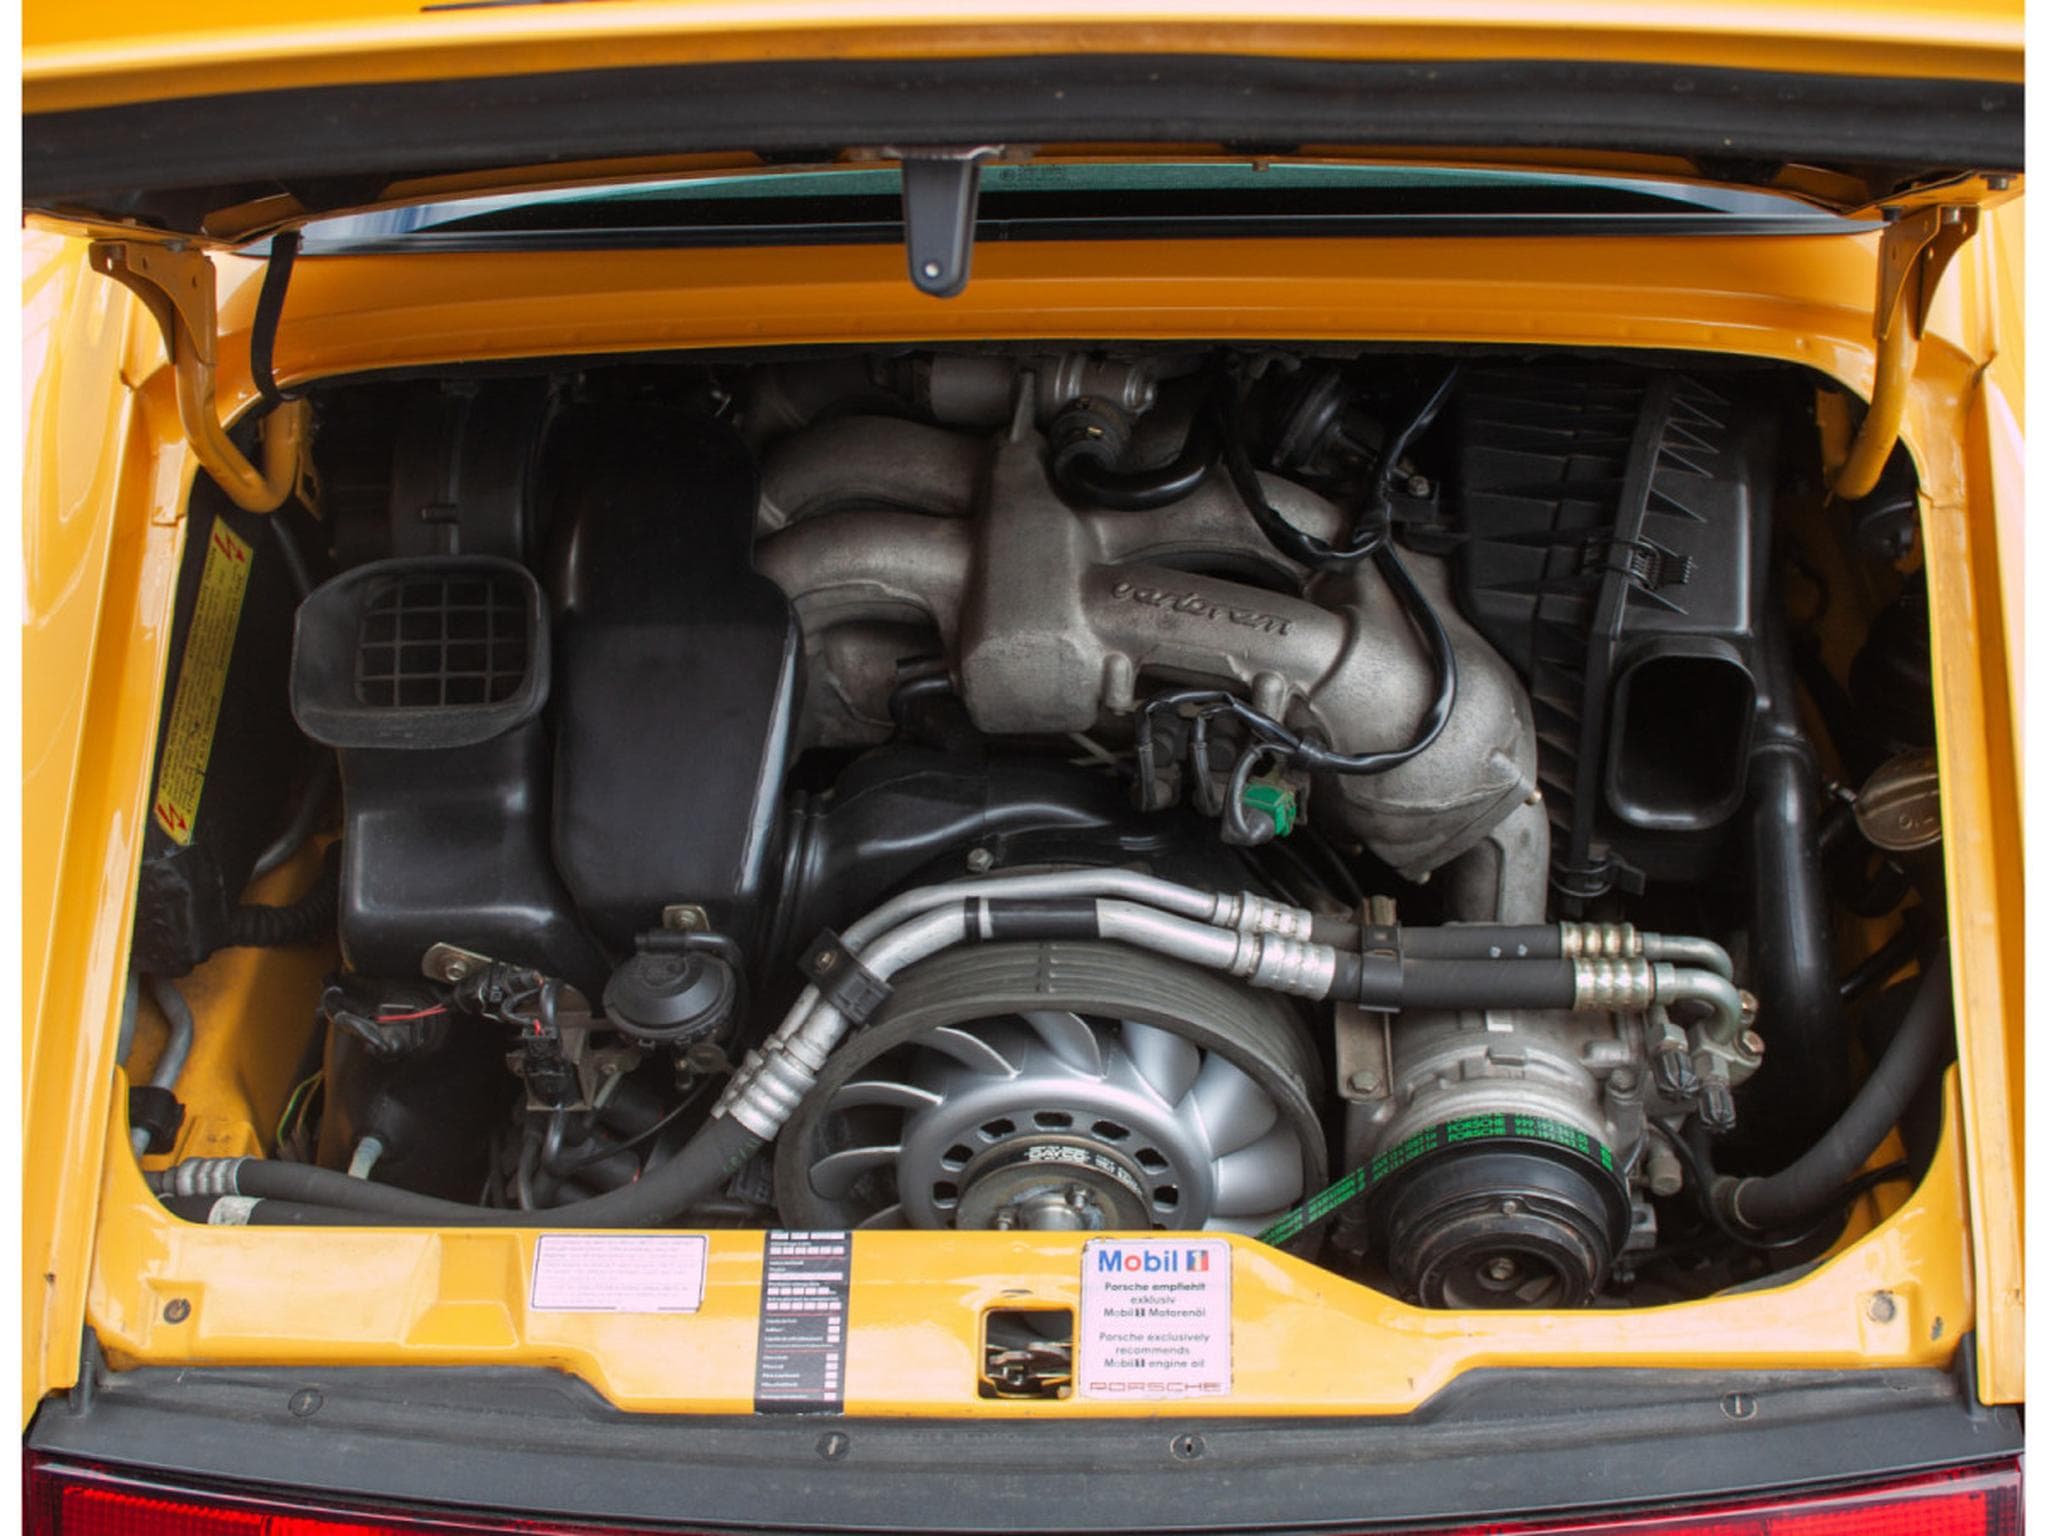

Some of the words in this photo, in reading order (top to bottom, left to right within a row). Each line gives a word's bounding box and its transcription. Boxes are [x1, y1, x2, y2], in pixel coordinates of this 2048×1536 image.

[1098, 1250, 1178, 1272] Mobil
[1104, 1281, 1149, 1291] Porsche
[1152, 1281, 1206, 1292] empfiehlt
[1130, 1294, 1176, 1304] exklusiv
[1099, 1332, 1144, 1341] Porsche
[1147, 1331, 1210, 1343] exclusively
[1115, 1346, 1190, 1355] recommends
[1149, 1359, 1187, 1370] engine
[1191, 1358, 1204, 1367] oil
[1089, 1381, 1222, 1393] PORSCHE
